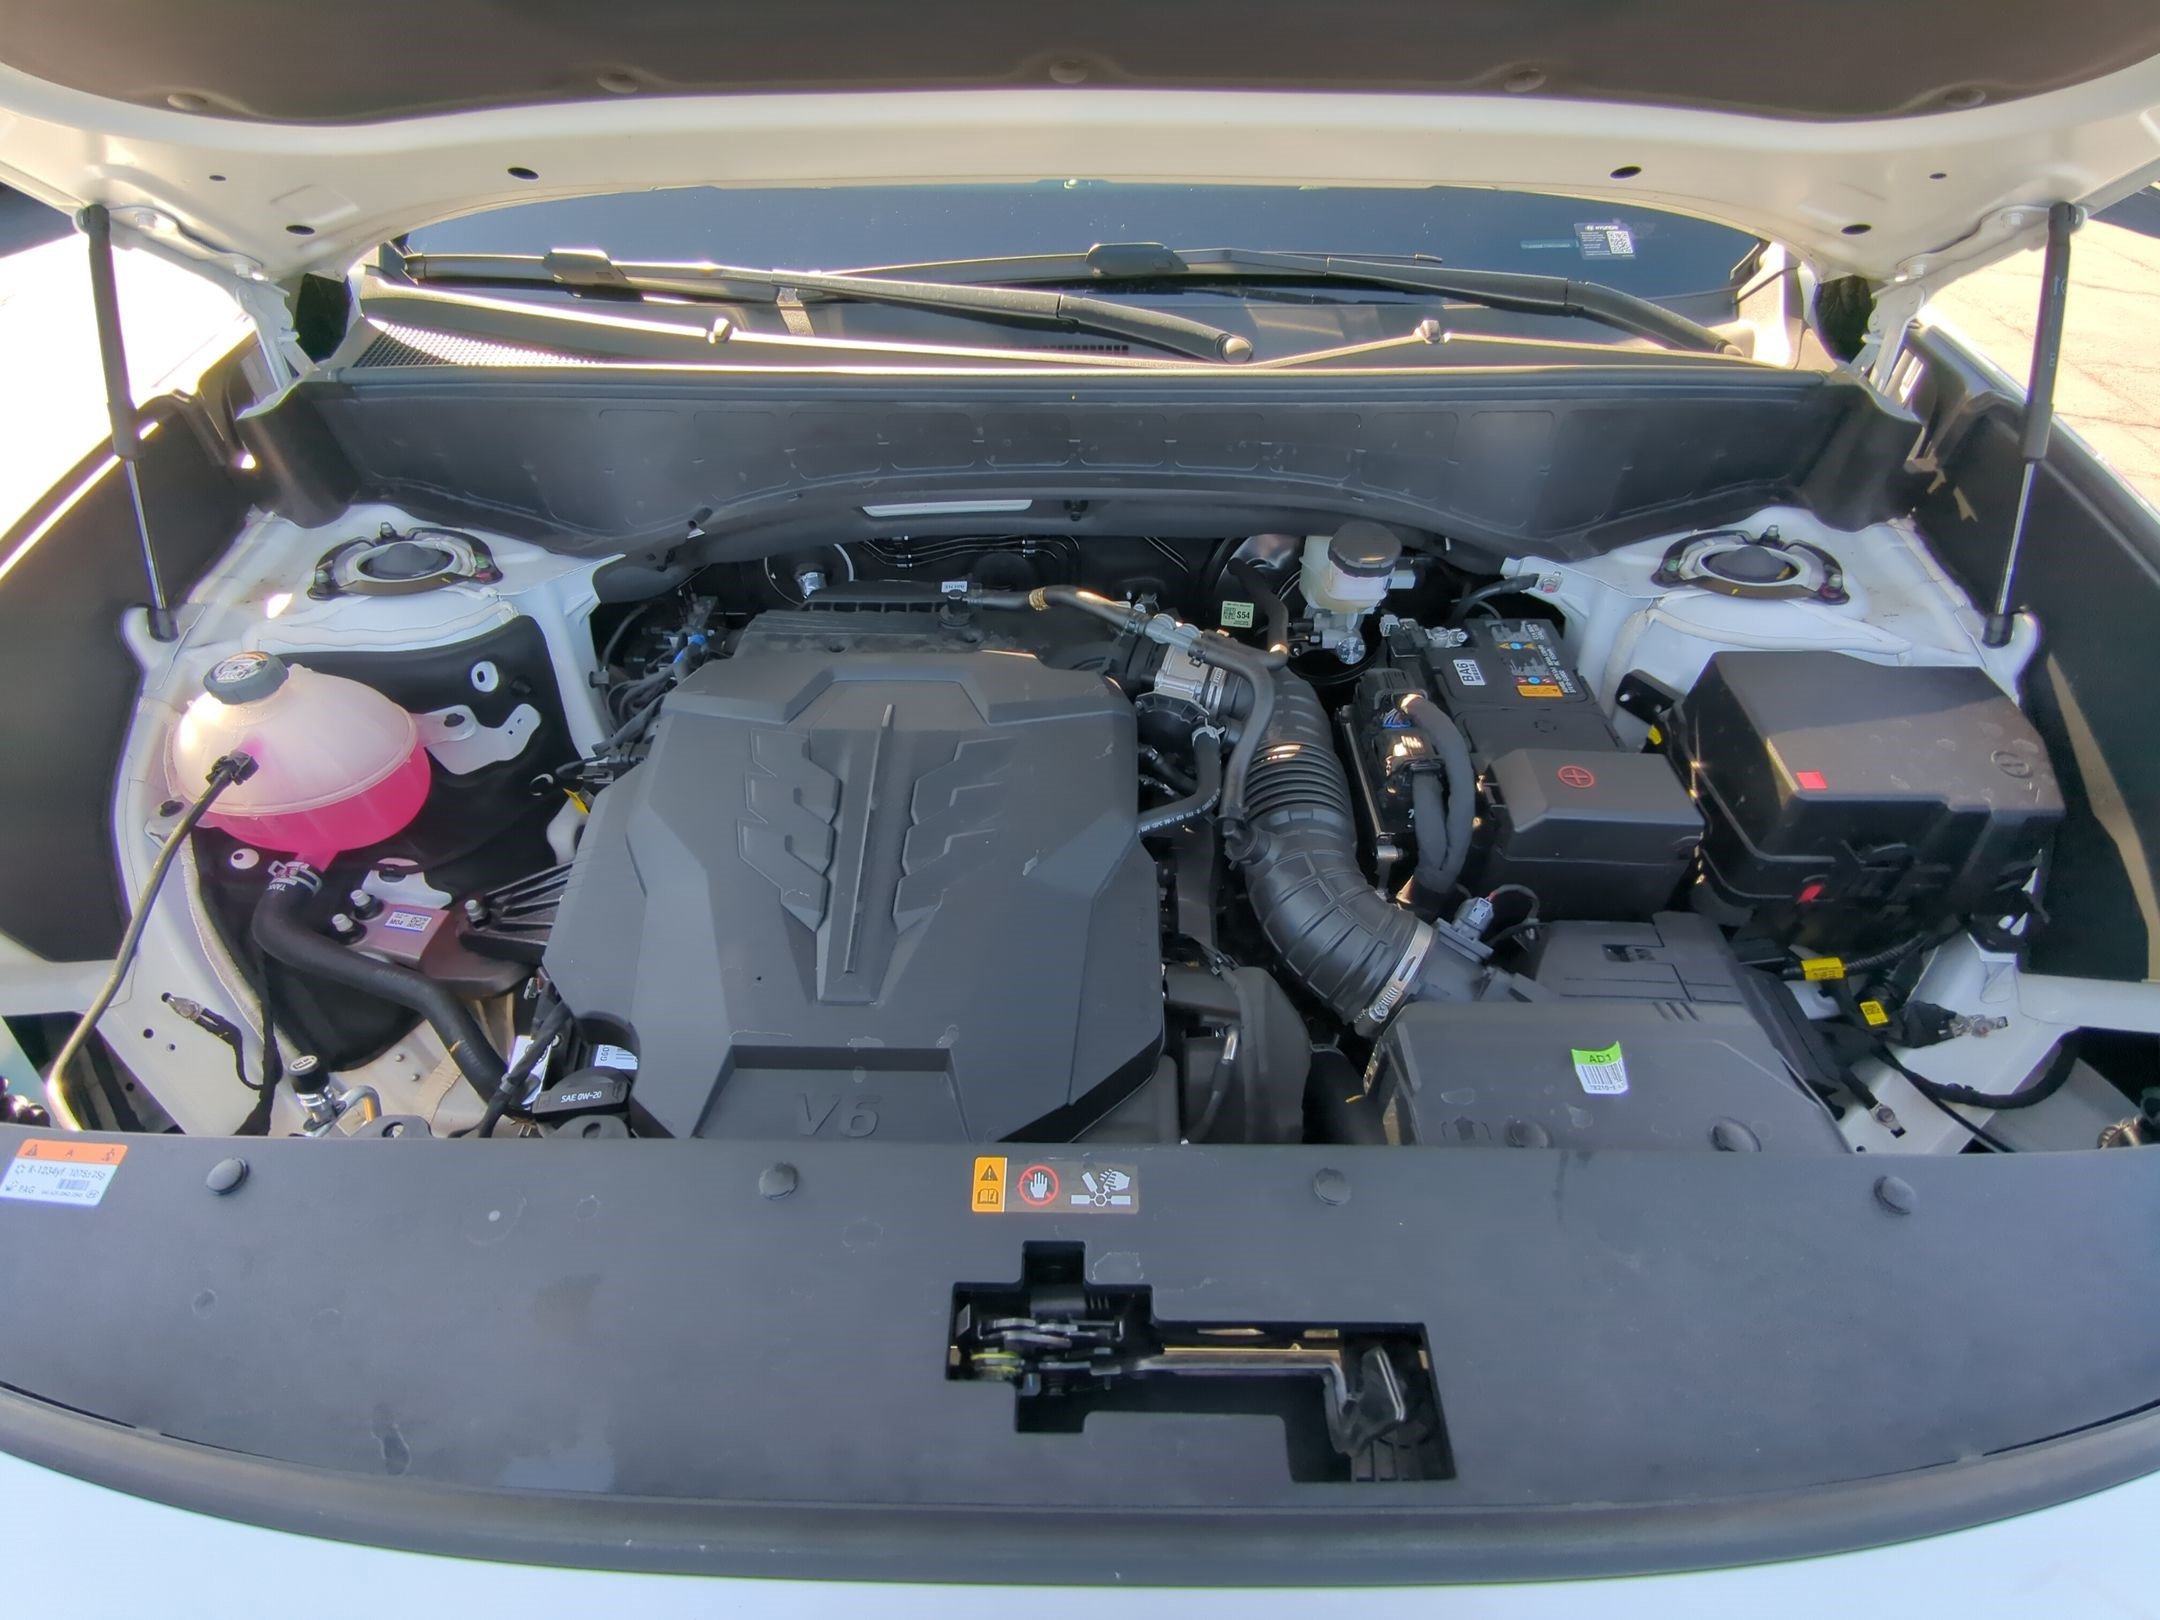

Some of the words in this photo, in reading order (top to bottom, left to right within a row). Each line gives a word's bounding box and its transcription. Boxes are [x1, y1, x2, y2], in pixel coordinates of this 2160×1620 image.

[1236, 610, 1250, 620] S54
[1456, 662, 1475, 682] BA6
[560, 1093, 577, 1103] SAE
[797, 1093, 882, 1139] V6
